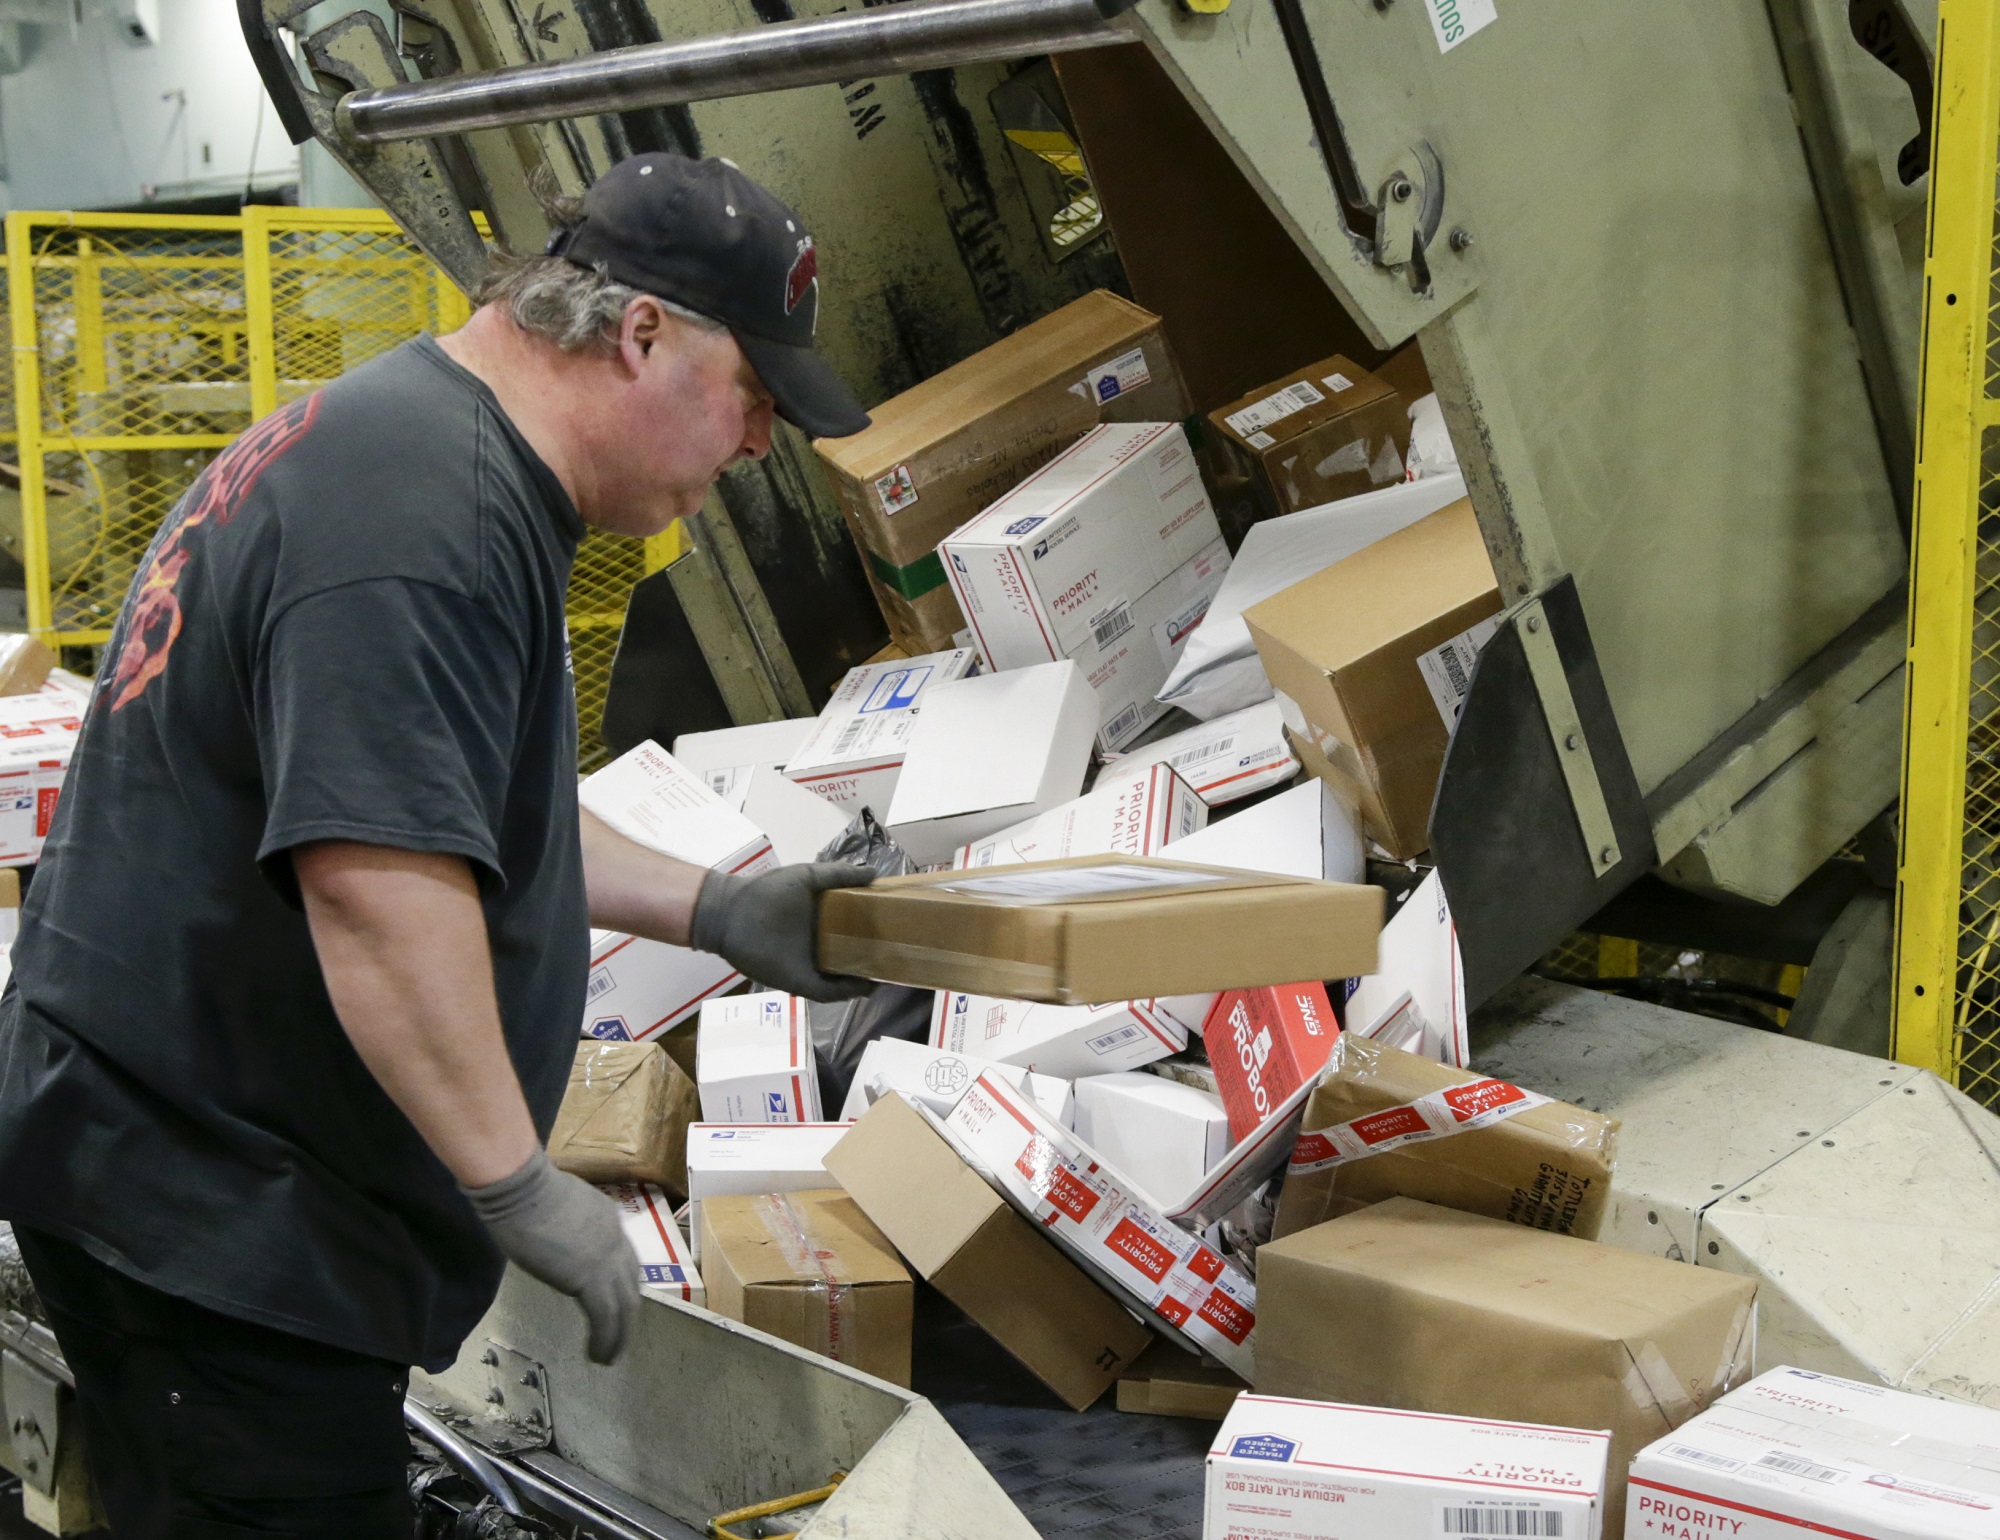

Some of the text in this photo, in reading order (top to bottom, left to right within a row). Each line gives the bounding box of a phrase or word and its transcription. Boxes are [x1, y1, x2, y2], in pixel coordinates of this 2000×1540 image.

[1433, 0, 1464, 42] SOU
[1114, 425, 1162, 460] PRIORITY
[996, 568, 1013, 600] MAIL
[998, 553, 1032, 616] PRIORITY
[1052, 569, 1099, 611] PRIORITY
[1068, 590, 1093, 613] MAIL
[844, 667, 872, 702] PRIORITY
[637, 760, 655, 777] MAIL
[640, 748, 675, 776] PRIORITY
[826, 792, 848, 802] AIL
[1110, 807, 1125, 850] MAIL
[1242, 1010, 1254, 1042] GNC
[1296, 995, 1318, 1036] GNC
[1306, 996, 1324, 1036] LIVE WELL
[1455, 1082, 1506, 1104] PRIORITY
[964, 1090, 996, 1122] PRIORITY
[1361, 1113, 1410, 1134] PRIORITY
[1379, 1124, 1406, 1136] MAIL
[1117, 1238, 1163, 1275] PRIORITY
[1135, 1237, 1159, 1259] MAIL
[1203, 1304, 1241, 1335] PRIORIT
[1214, 1298, 1237, 1319] MAIL
[1754, 1386, 1850, 1413] PRIORITY
[1769, 1396, 1817, 1412] MAIL
[1243, 1439, 1288, 1450] INSURED
[1522, 1432, 1546, 1441] FLAT
[1548, 1434, 1591, 1444] MEDIUM
[1704, 1420, 1803, 1449] LARGE FLAT RATE BOX
[1239, 1448, 1284, 1458] TRACKED
[1241, 1473, 1299, 1487] INTERNATIONAL
[1462, 1467, 1583, 1487] PRIORITY
[1494, 1463, 1557, 1475] MAIL
[1225, 1480, 1346, 1503] MEDIUM FLAT RATE BOX
[1301, 1481, 1319, 1489] AND
[1319, 1483, 1358, 1494] DOMESTIC
[1359, 1487, 1376, 1496] FOR
[1897, 1482, 1931, 1492] Letter
[1639, 1496, 1744, 1535] PRIORITY
[1228, 1525, 1256, 1533] ONLINE
[1257, 1528, 1291, 1539] SUPPLIES
